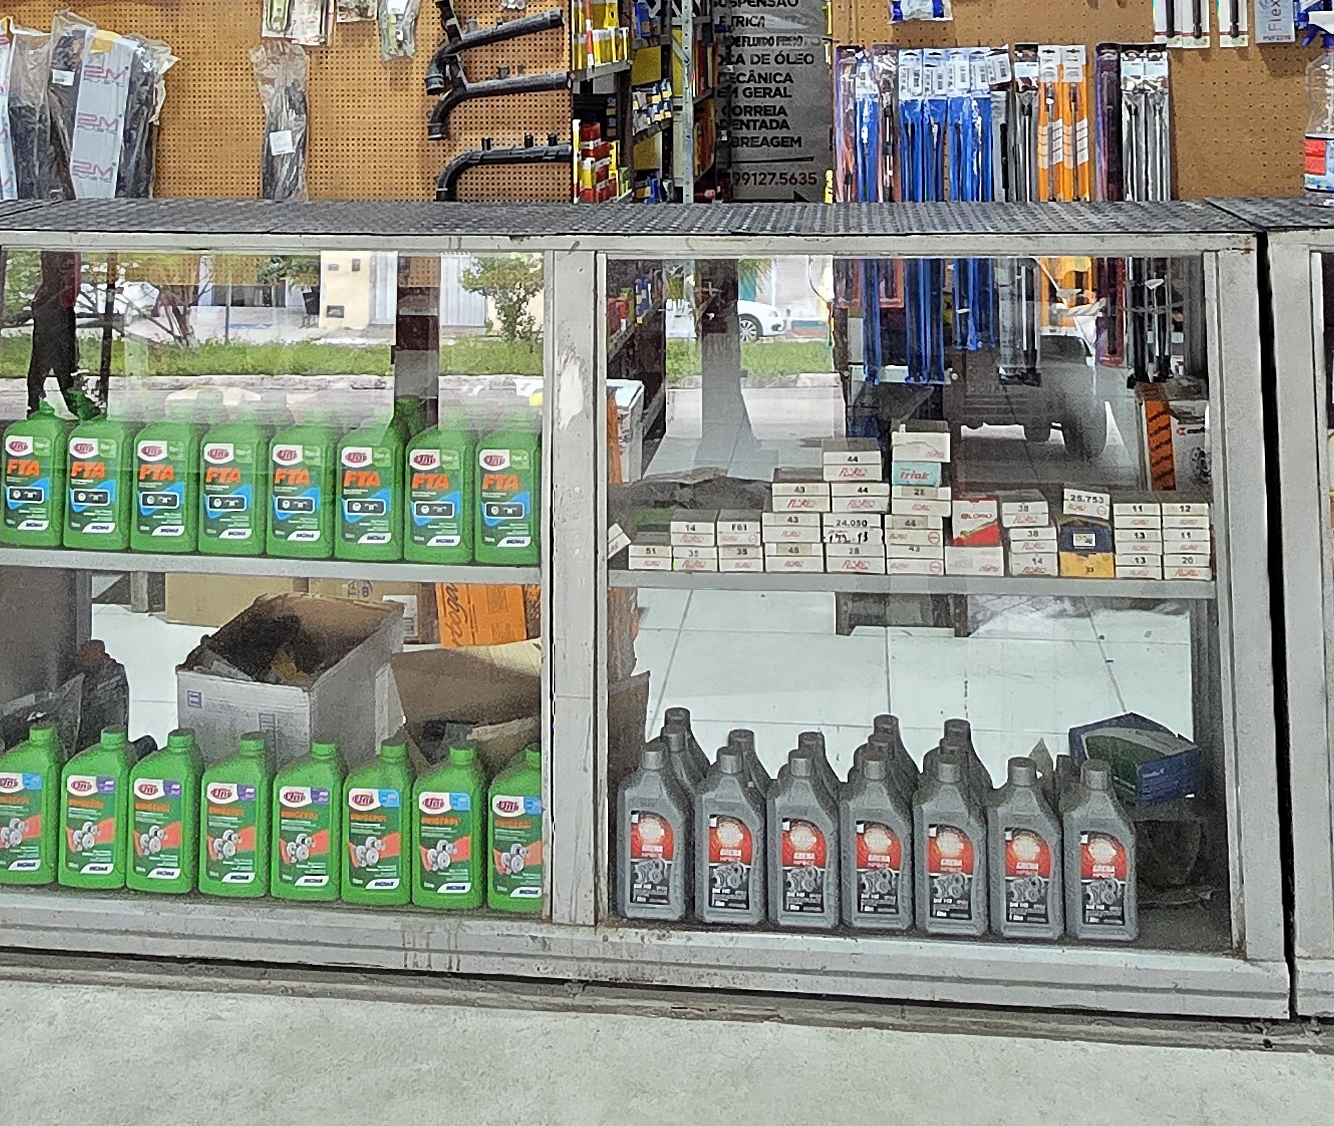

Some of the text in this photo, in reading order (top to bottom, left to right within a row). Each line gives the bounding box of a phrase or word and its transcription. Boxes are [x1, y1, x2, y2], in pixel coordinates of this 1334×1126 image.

[750, 53, 770, 65] DE
[774, 50, 815, 65] ÓLEO
[743, 87, 792, 98] GERAL
[732, 136, 802, 148] BREAGEM
[7, 459, 40, 476] FTA
[71, 461, 105, 478] FTA
[139, 464, 174, 481] FTA
[206, 467, 240, 483] FTA
[274, 469, 310, 485] FTA
[344, 471, 380, 487] FTA
[412, 473, 450, 490] FTA
[482, 473, 520, 490] FTA
[857, 486, 868, 494] 44
